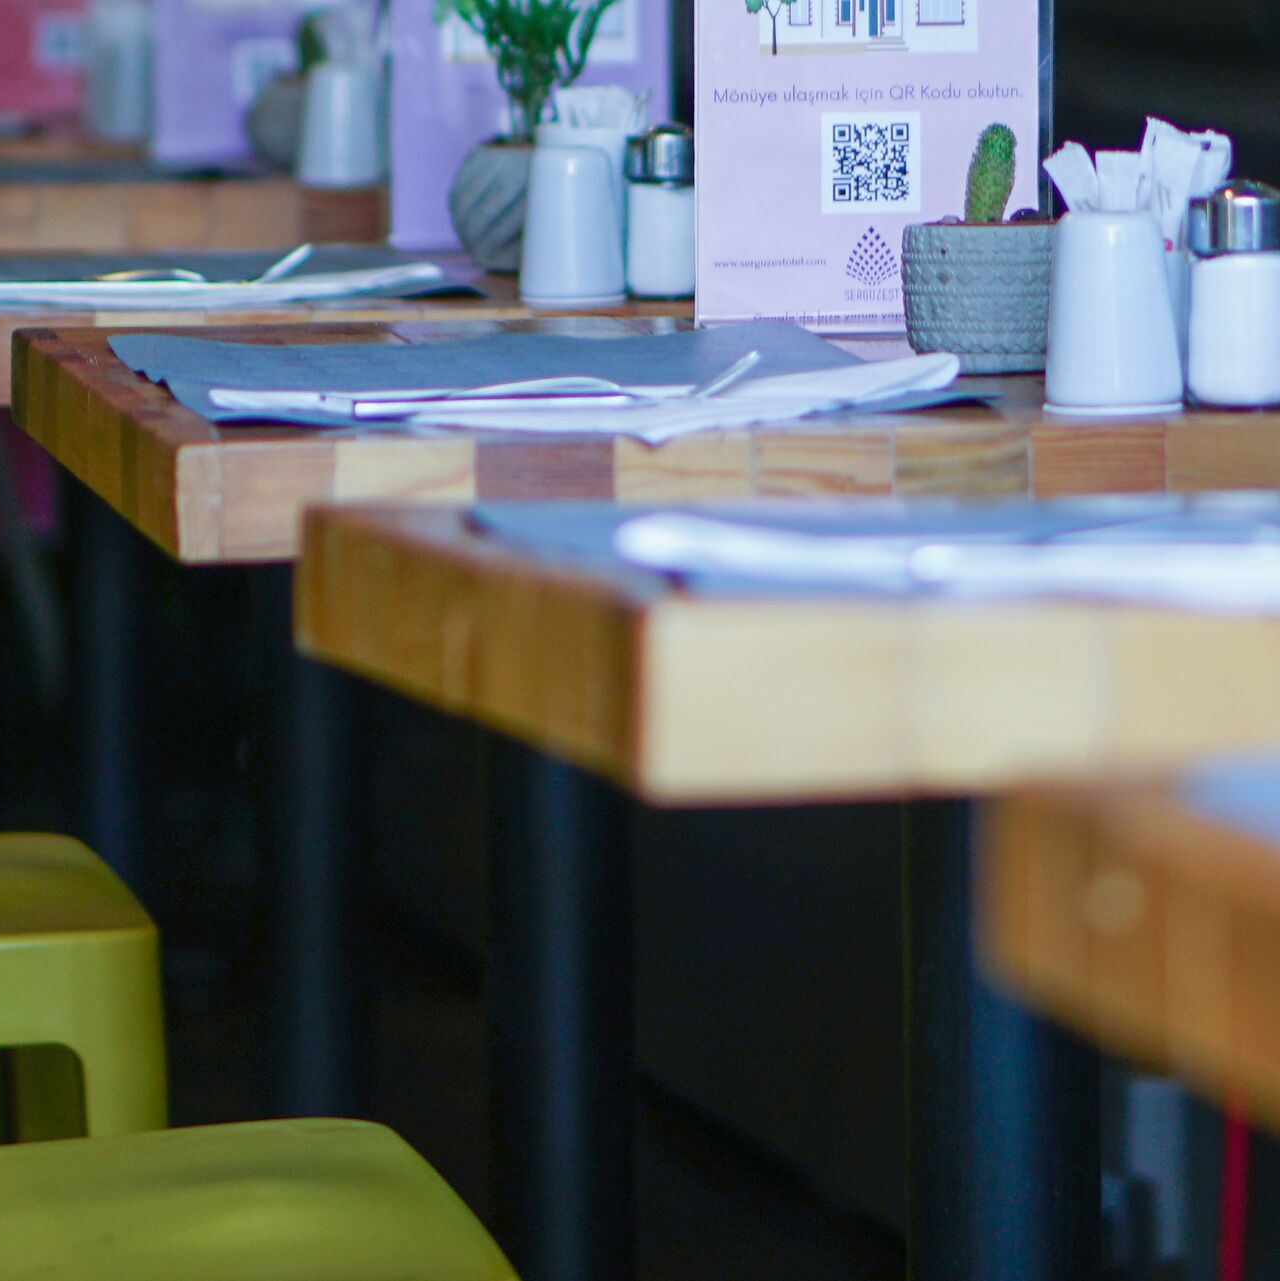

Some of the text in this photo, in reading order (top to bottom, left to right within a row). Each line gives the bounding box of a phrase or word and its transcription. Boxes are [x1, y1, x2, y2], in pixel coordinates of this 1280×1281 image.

[713, 80, 1023, 108] Mönüye ulaşmak için QR Kodu okutun.
[713, 256, 827, 269] www.serguzestotel.com
